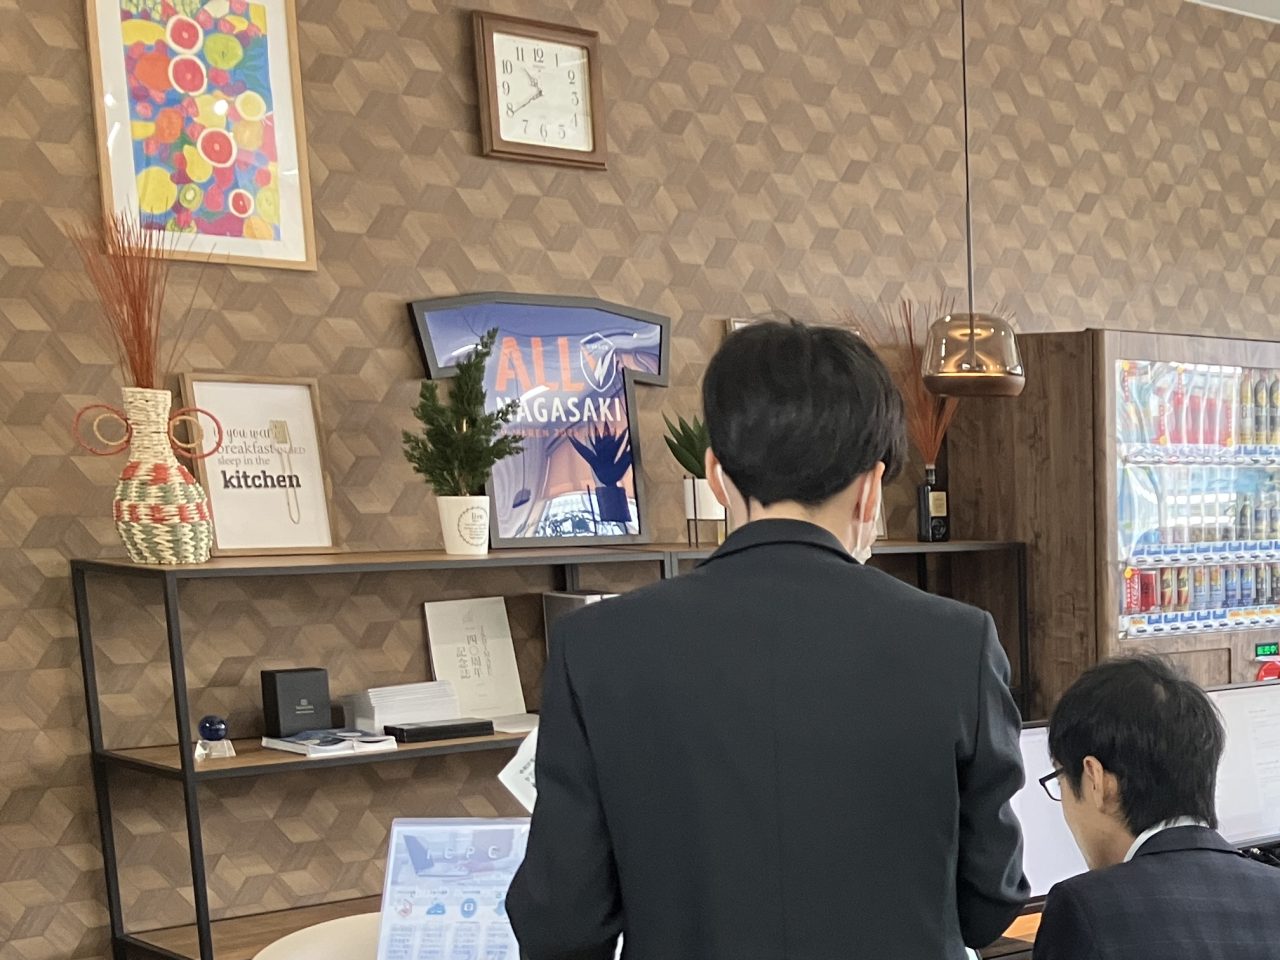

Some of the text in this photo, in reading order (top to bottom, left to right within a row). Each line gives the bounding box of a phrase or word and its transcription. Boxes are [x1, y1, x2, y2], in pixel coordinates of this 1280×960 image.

[516, 46, 525, 62] 11
[534, 48, 544, 63] 12
[502, 59, 513, 75] 10
[568, 69, 575, 84] 2
[502, 80, 510, 96] 9
[572, 91, 579, 106] 3
[506, 102, 515, 118] 8
[522, 119, 529, 134] 7
[540, 123, 548, 138] 6
[558, 124, 566, 139] 5
[495, 336, 585, 391] ALL
[496, 396, 622, 422] NAGASAKI
[226, 428, 246, 444] you
[218, 455, 271, 468] sleep in the
[221, 469, 302, 489] kitchen
